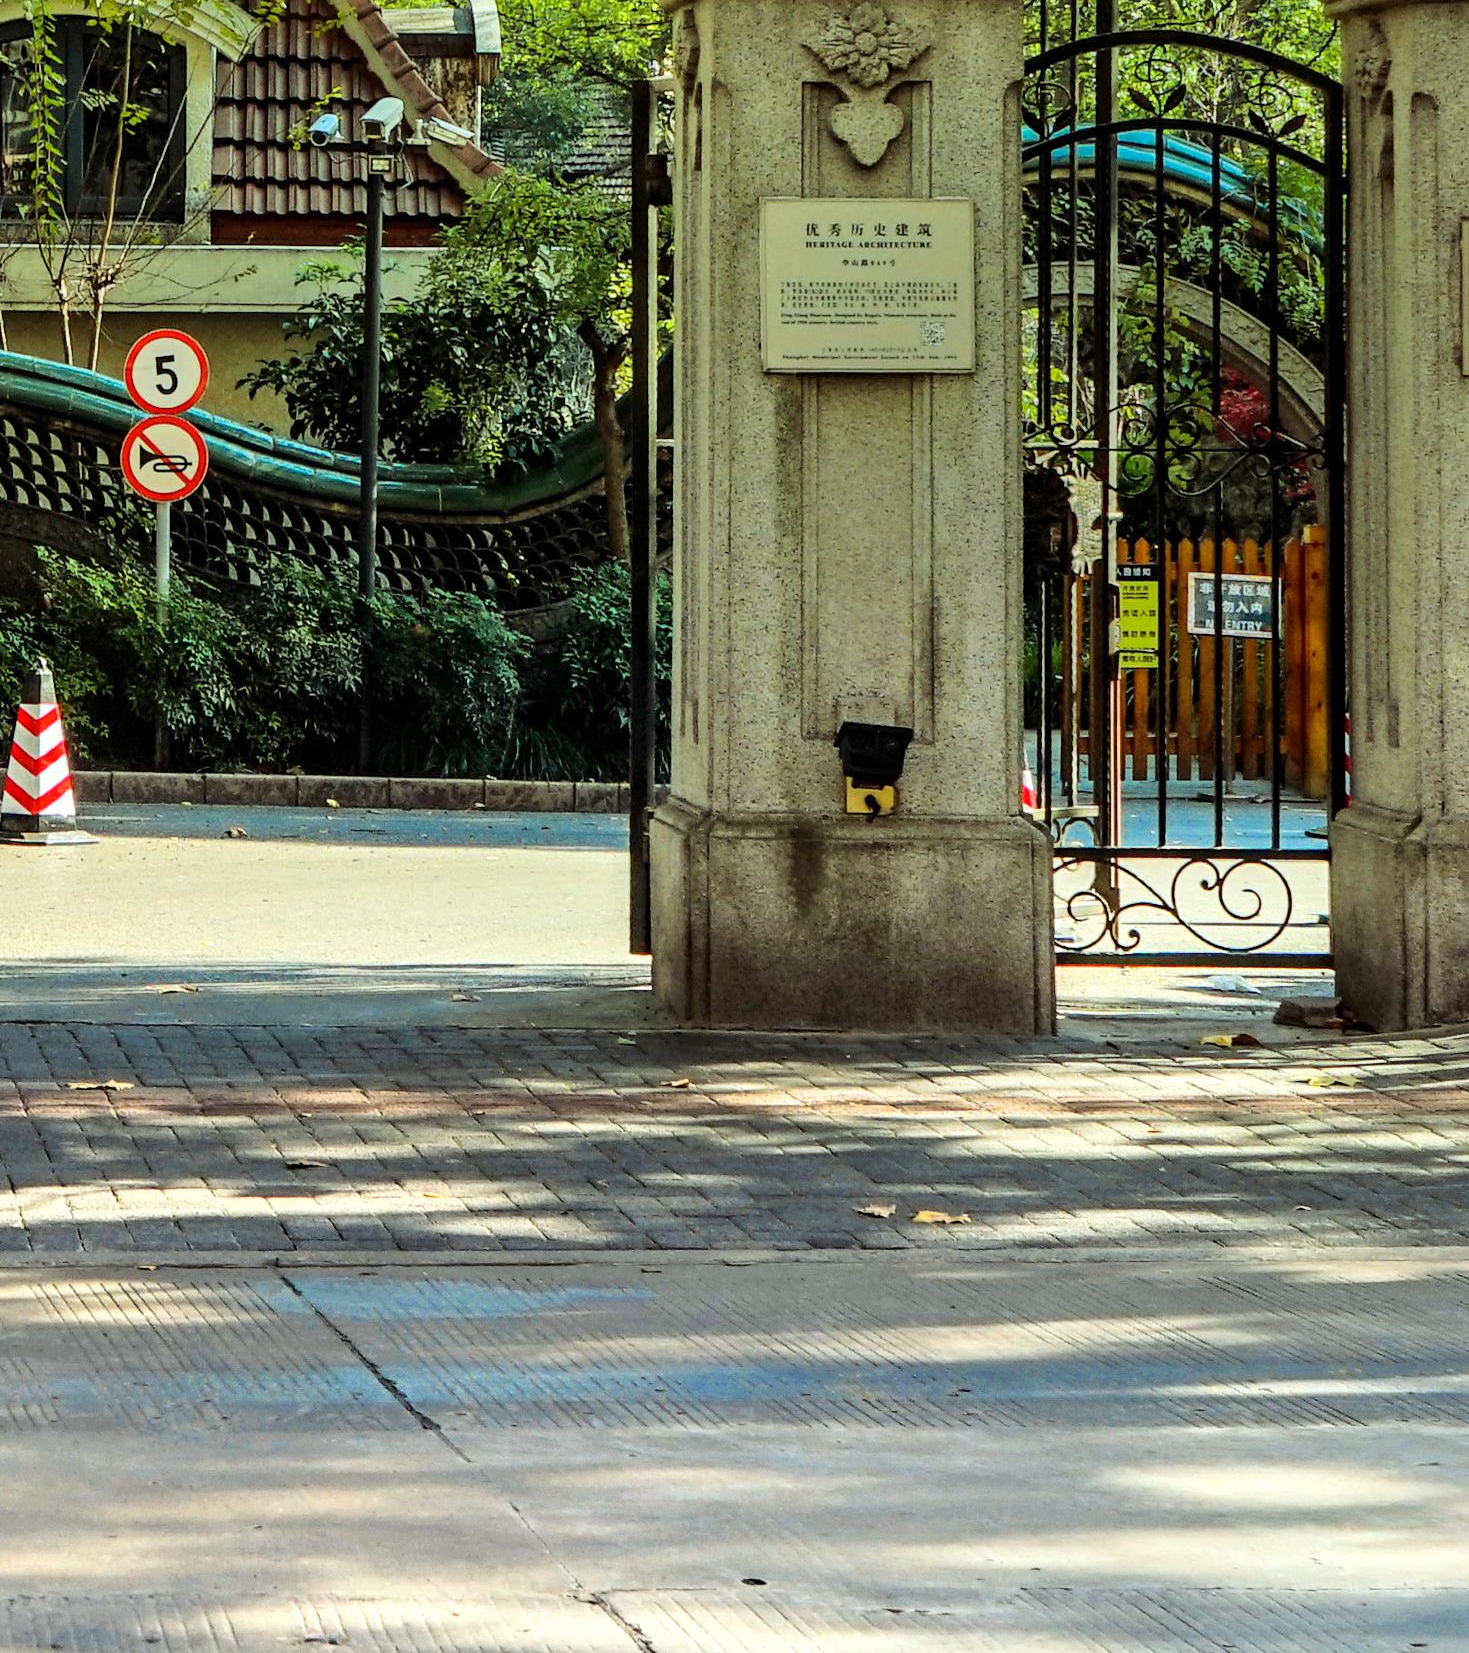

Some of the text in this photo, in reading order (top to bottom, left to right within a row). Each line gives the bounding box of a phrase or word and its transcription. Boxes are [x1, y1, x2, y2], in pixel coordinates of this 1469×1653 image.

[806, 223, 932, 237] 优秀历史建筑
[155, 355, 178, 395] 5
[1224, 620, 1263, 631] ENTRY
